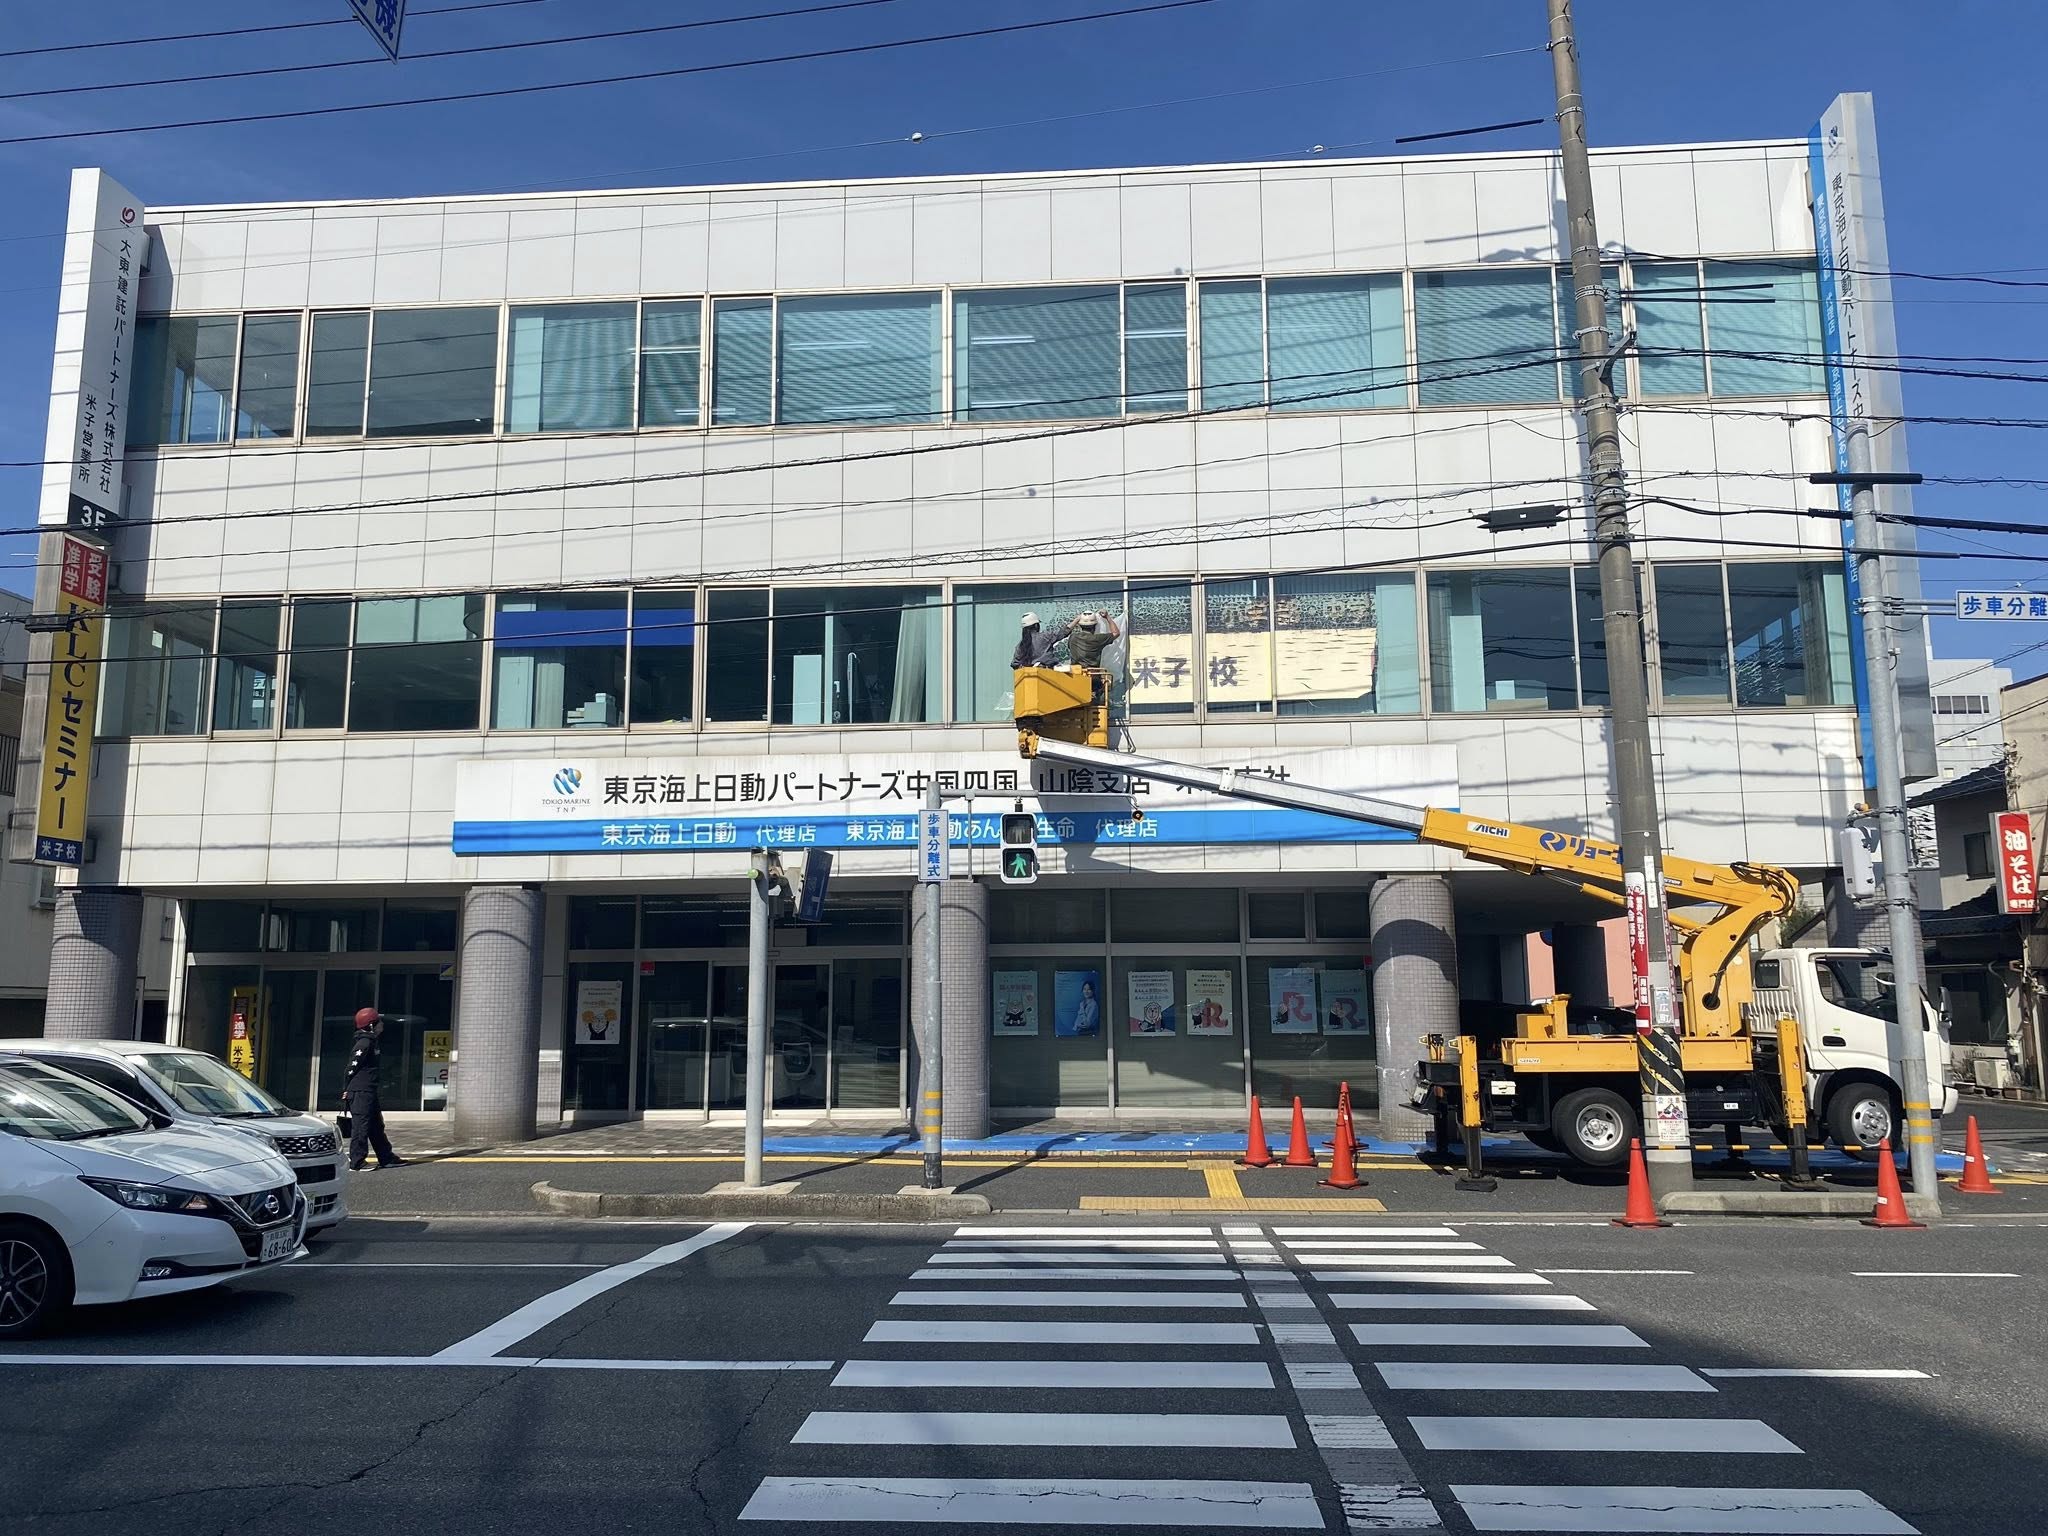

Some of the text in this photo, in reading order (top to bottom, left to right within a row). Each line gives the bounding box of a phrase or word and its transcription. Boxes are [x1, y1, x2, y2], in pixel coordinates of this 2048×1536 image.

[99, 240, 132, 495] 大東建託パートナーズ株式会社
[78, 393, 97, 482] 米子営業所
[64, 542, 81, 591] 進学
[86, 552, 103, 602] 受験
[1133, 656, 1238, 689] 米子校
[54, 601, 94, 830] KLCセミナー
[41, 840, 77, 860] 米子校
[601, 820, 736, 847] 東京海上日動
[756, 823, 816, 844] 代理店
[1095, 818, 1158, 838] 代理店
[927, 813, 941, 877] 歩車分離式
[1474, 824, 1508, 837] AICHI
[2004, 829, 2032, 895] 油そば
[233, 1046, 243, 1071] 米子
[268, 1238, 292, 1258] 68-60
